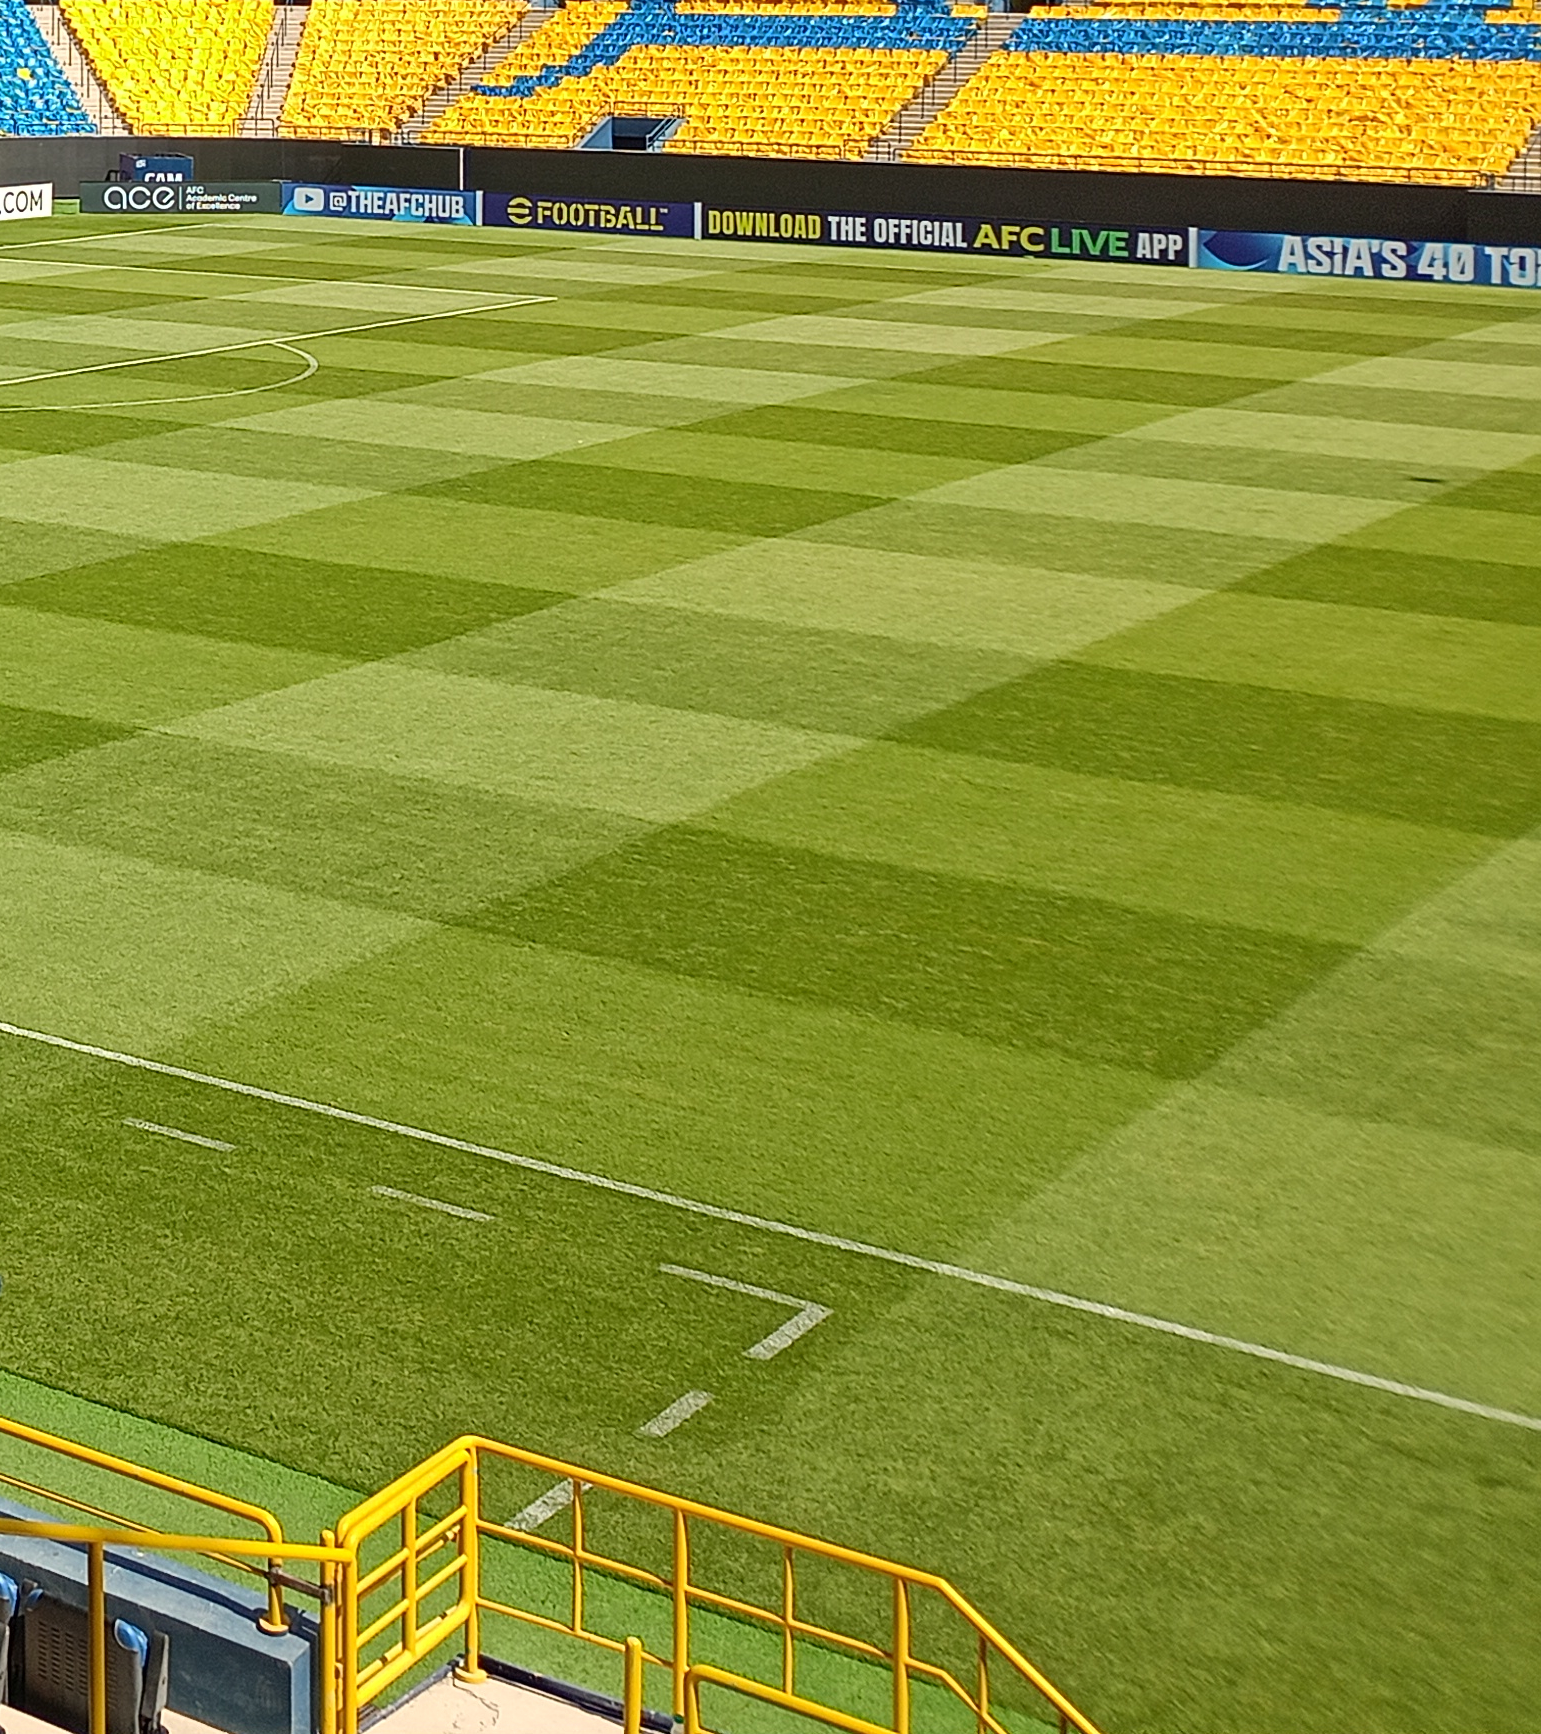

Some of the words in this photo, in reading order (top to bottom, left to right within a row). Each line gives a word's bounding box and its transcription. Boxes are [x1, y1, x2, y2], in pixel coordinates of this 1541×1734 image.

[103, 185, 175, 210] ace
[185, 186, 204, 194] AFC
[185, 194, 227, 202] Academic
[228, 194, 257, 203] Centre
[329, 190, 465, 218] @THEAFCHUB
[708, 209, 821, 239] DOWNLOAD
[827, 215, 867, 242] THE
[873, 218, 968, 248] OFFICIAL
[972, 223, 1045, 252] AFC
[1050, 227, 1130, 257] LIVE
[1136, 232, 1183, 261] APP
[1277, 235, 1407, 279] ASIA'S
[1417, 241, 1475, 283] 40
[1484, 245, 1541, 287] TO
